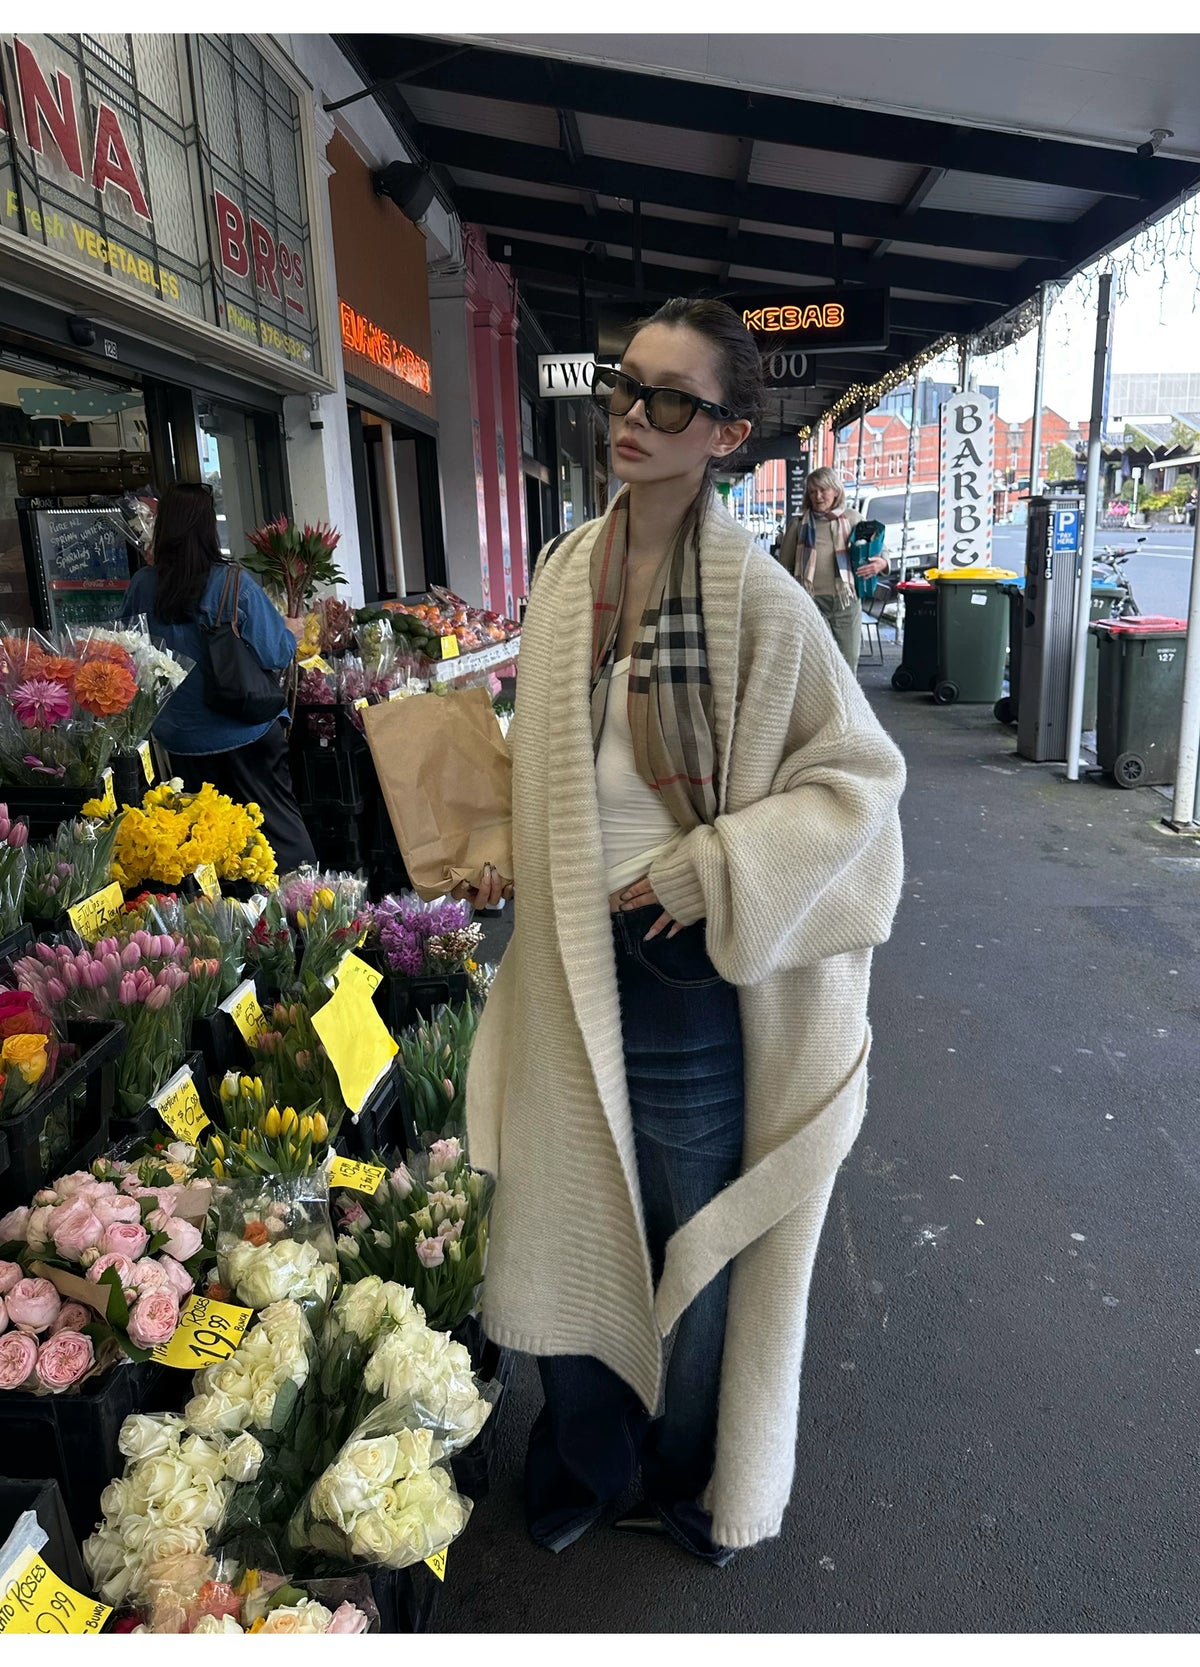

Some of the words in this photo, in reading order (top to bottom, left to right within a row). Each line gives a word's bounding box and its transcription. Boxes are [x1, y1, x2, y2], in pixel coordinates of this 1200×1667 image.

[71, 222, 180, 300] VEGETABLES
[742, 303, 844, 331] KEBAB
[180, 1297, 210, 1327] ROSES
[6, 1564, 46, 1613] ROSES
